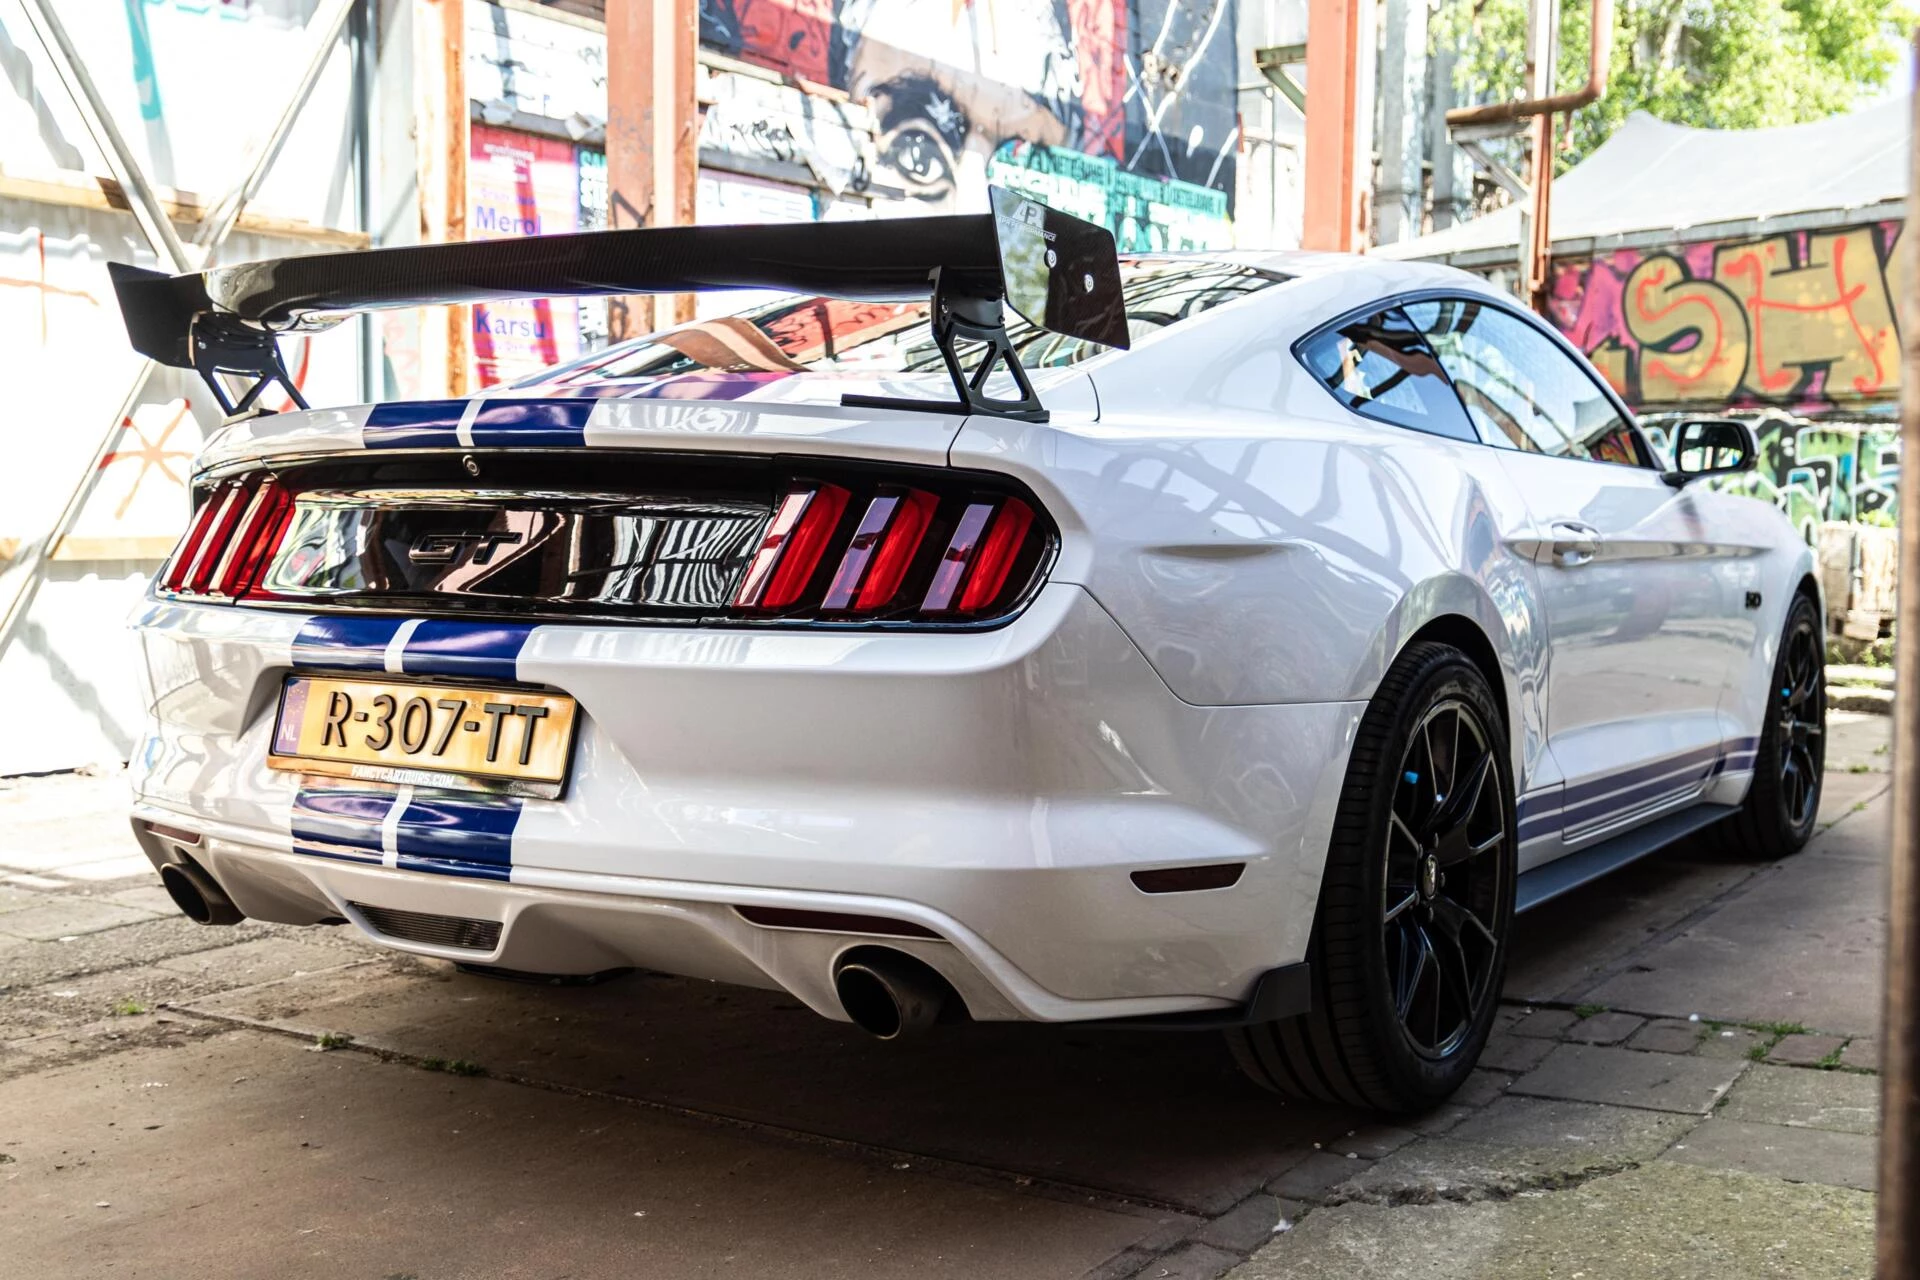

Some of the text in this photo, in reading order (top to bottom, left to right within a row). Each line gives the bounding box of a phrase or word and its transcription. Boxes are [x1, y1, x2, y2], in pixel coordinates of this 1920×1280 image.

[475, 308, 545, 338] Karsu
[409, 531, 523, 565] GT
[280, 724, 297, 741] NL
[320, 690, 549, 765] R-307-TT
